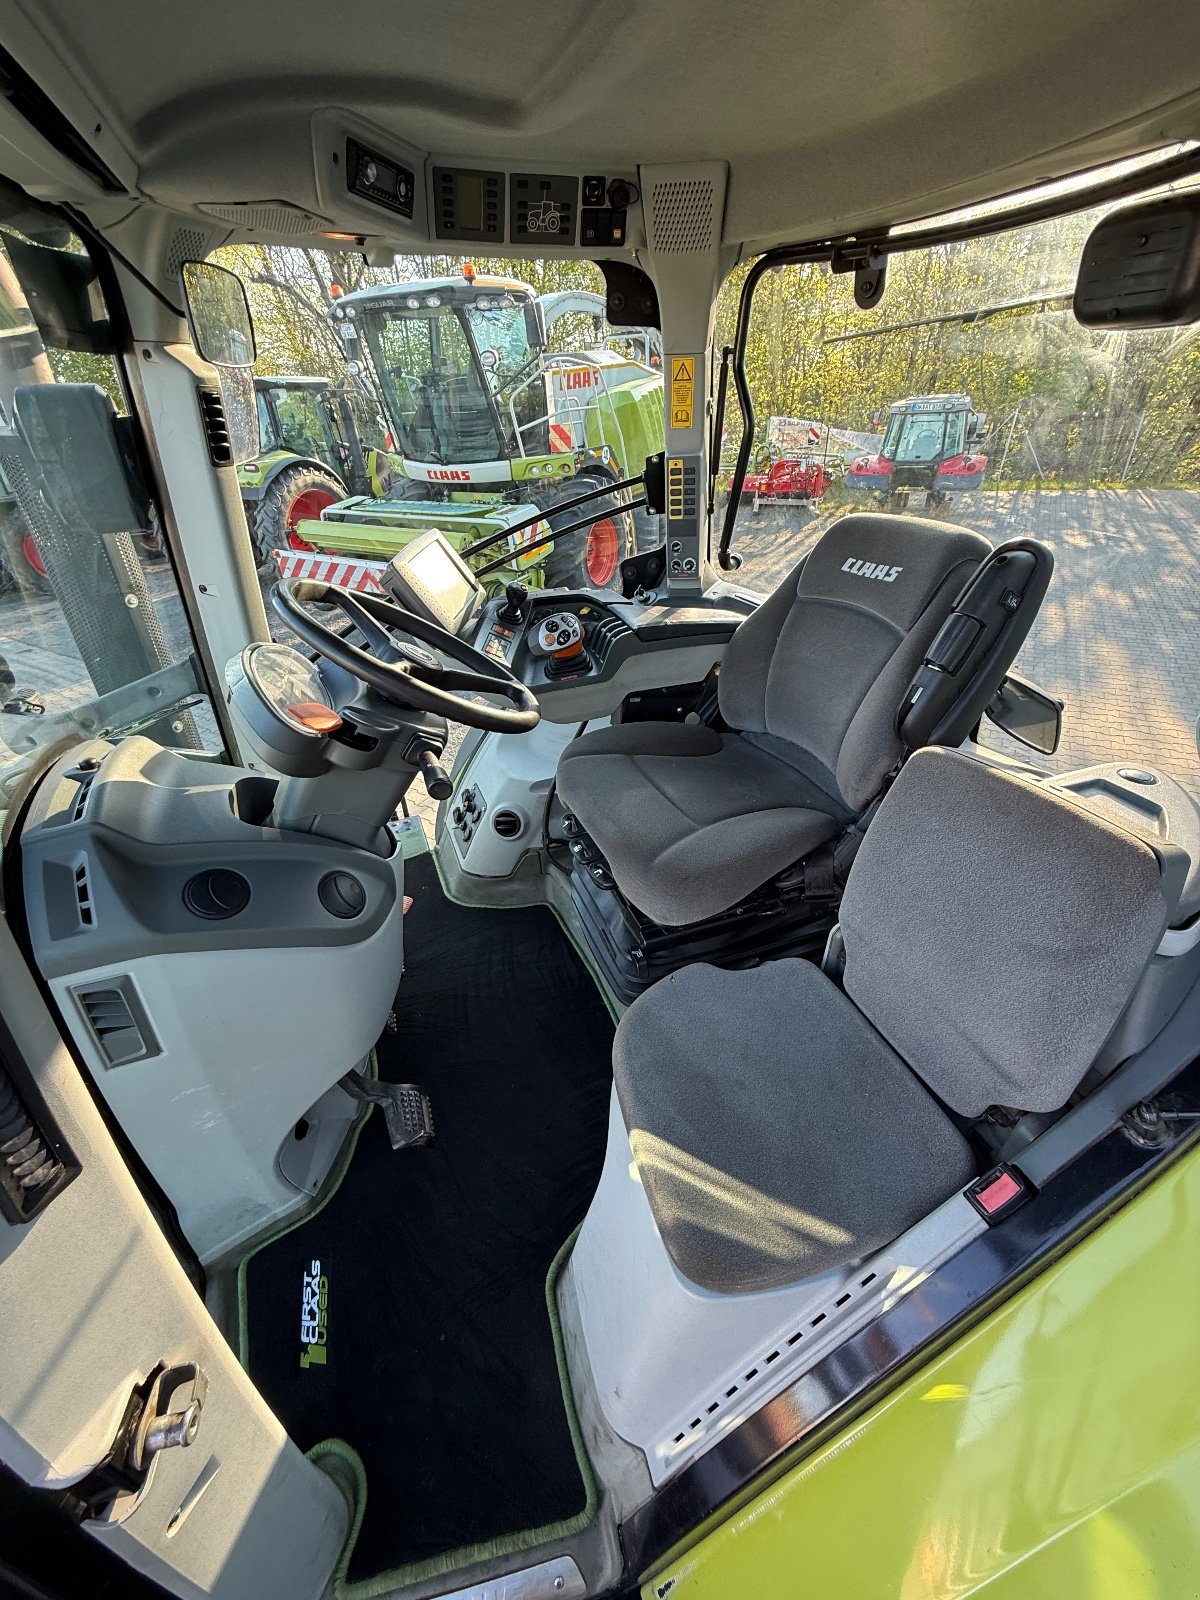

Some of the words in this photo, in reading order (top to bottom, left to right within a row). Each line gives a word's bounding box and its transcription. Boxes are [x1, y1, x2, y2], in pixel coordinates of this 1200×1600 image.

[426, 470, 471, 480] CLAAS
[841, 557, 904, 583] CLAAS
[301, 1271, 313, 1343] FIRST
[309, 1259, 321, 1344] CLAAS
[317, 1275, 328, 1345] USED
